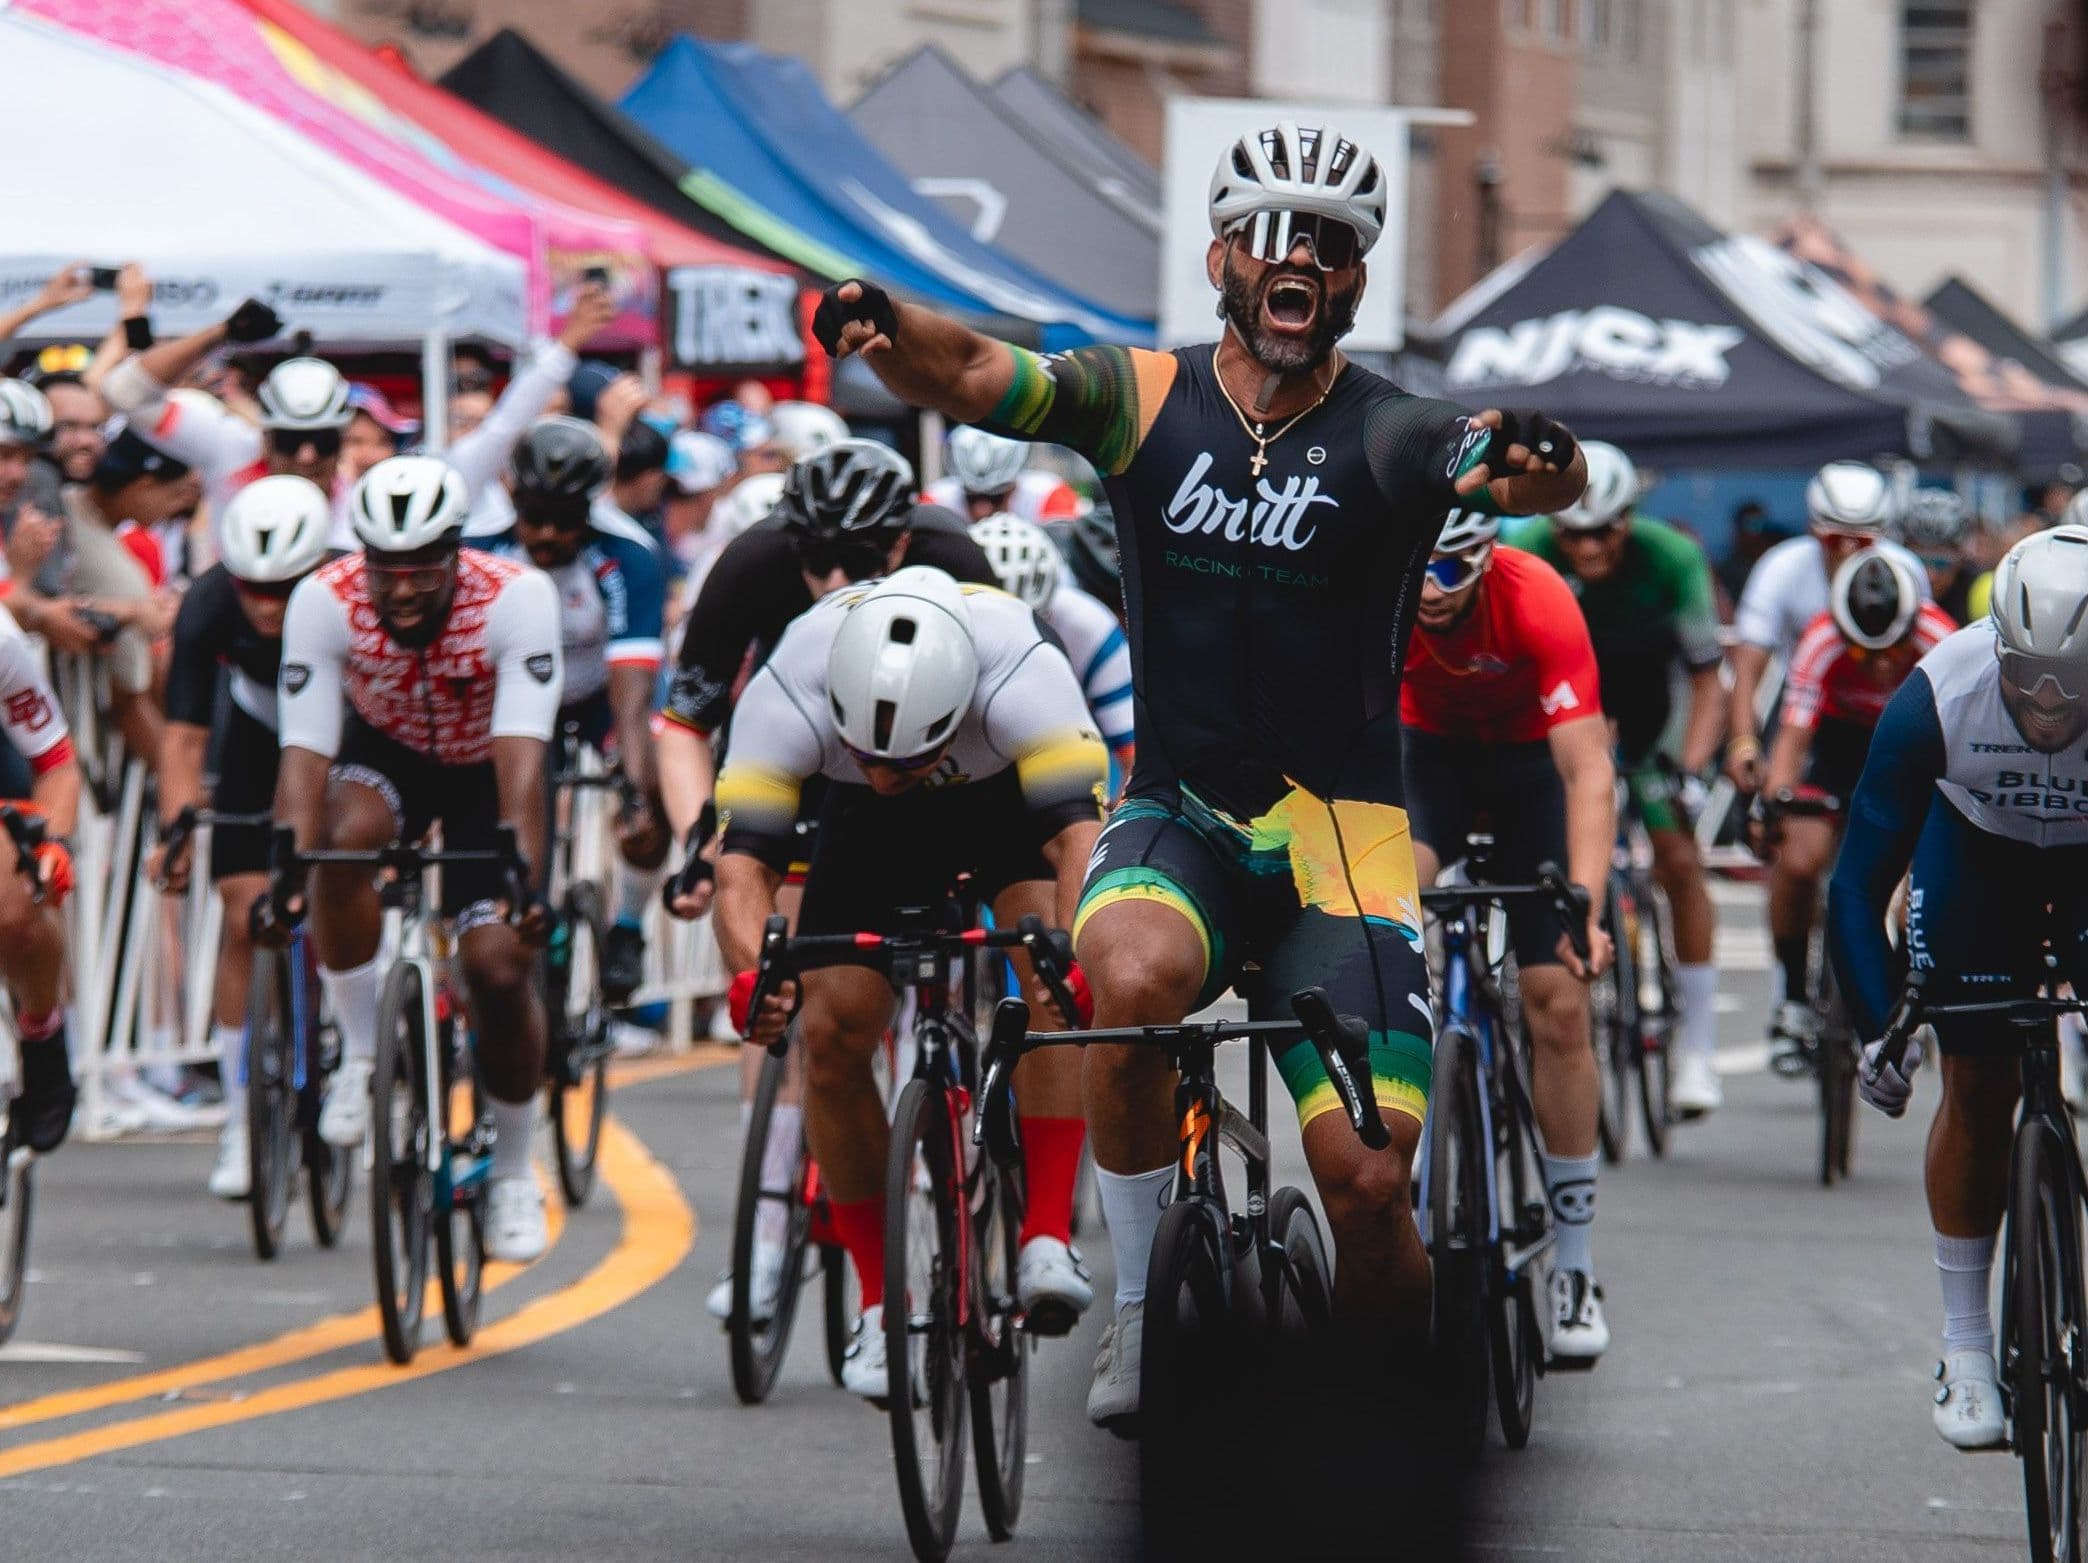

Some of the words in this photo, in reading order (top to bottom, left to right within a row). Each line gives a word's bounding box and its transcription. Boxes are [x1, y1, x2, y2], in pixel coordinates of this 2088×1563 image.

[669, 267, 806, 364] TREK
[1446, 305, 1745, 389] NJCX
[1161, 452, 1340, 550] britt
[1969, 743, 2033, 753] TREK
[1910, 888, 1935, 970] BLUE
